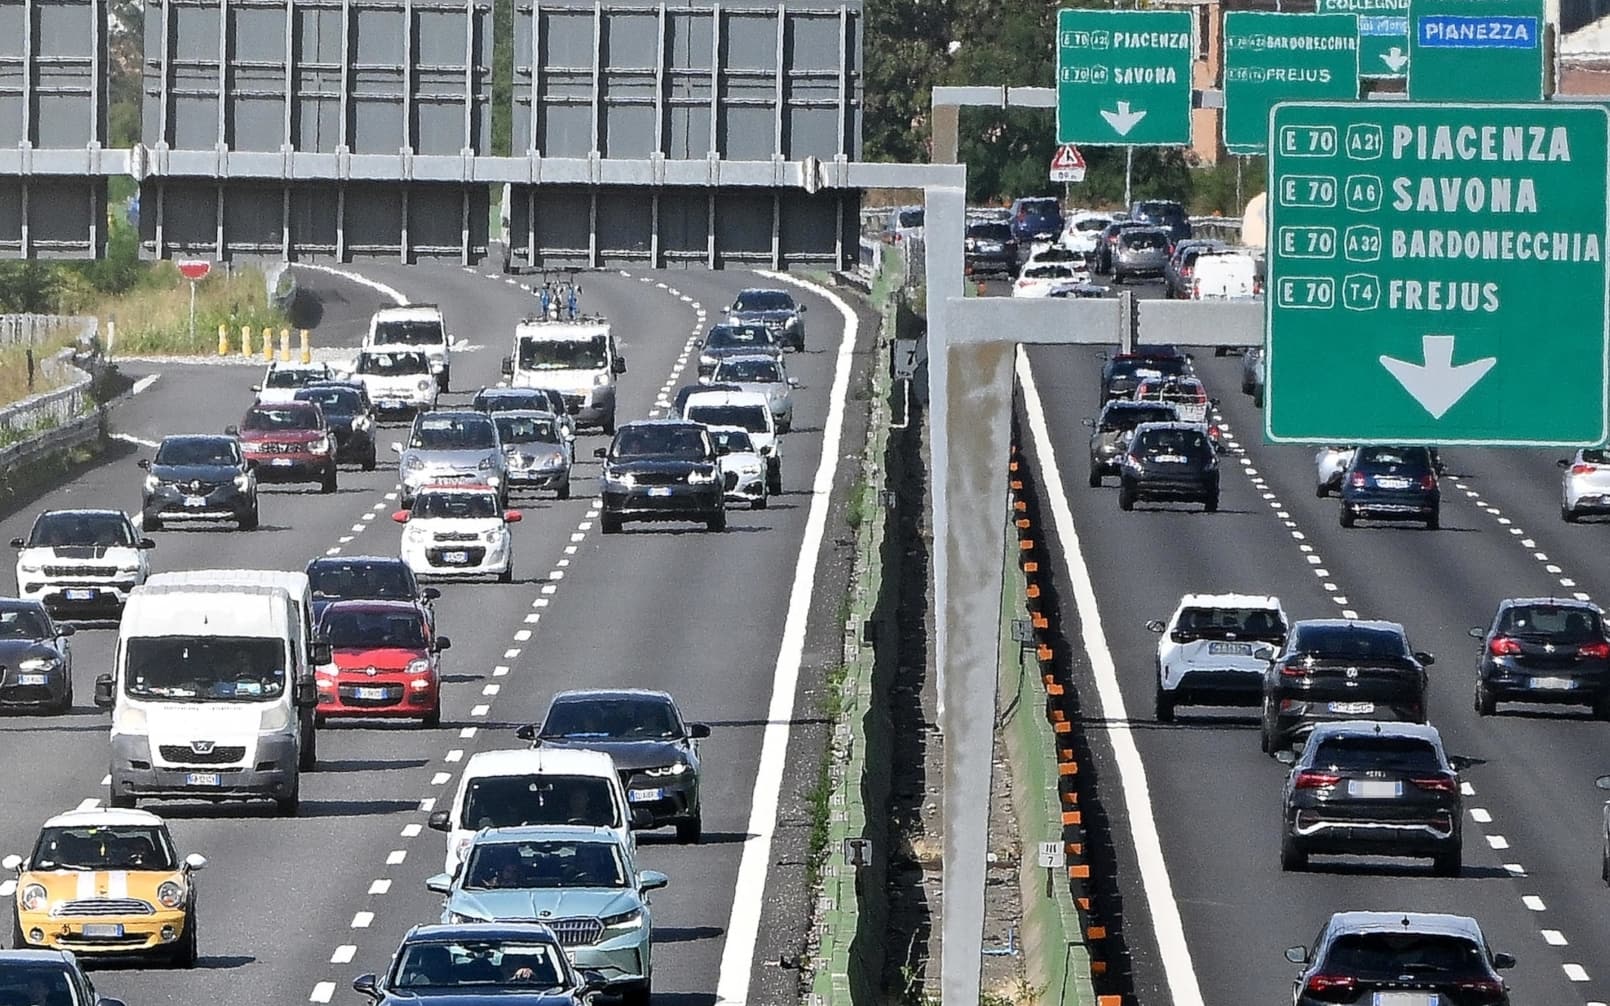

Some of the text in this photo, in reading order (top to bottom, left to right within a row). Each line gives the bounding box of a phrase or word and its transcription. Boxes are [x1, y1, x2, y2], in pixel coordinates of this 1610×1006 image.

[1425, 22, 1529, 40] PIANEZZA
[1113, 32, 1188, 48] PIACENZA
[1267, 36, 1356, 50] BARDONECCHIA
[1114, 67, 1176, 84] SAVONA
[1266, 69, 1331, 82] FREJUS
[1286, 125, 1571, 161] E 70 A21 PIACENZA
[1286, 177, 1537, 213] E 70 A6 SAVONA
[1285, 230, 1600, 262] E 70 A32 BARDONECCHIA
[1284, 280, 1500, 312] E 70 T4 FREJUS
[1048, 856, 1054, 866] 7
